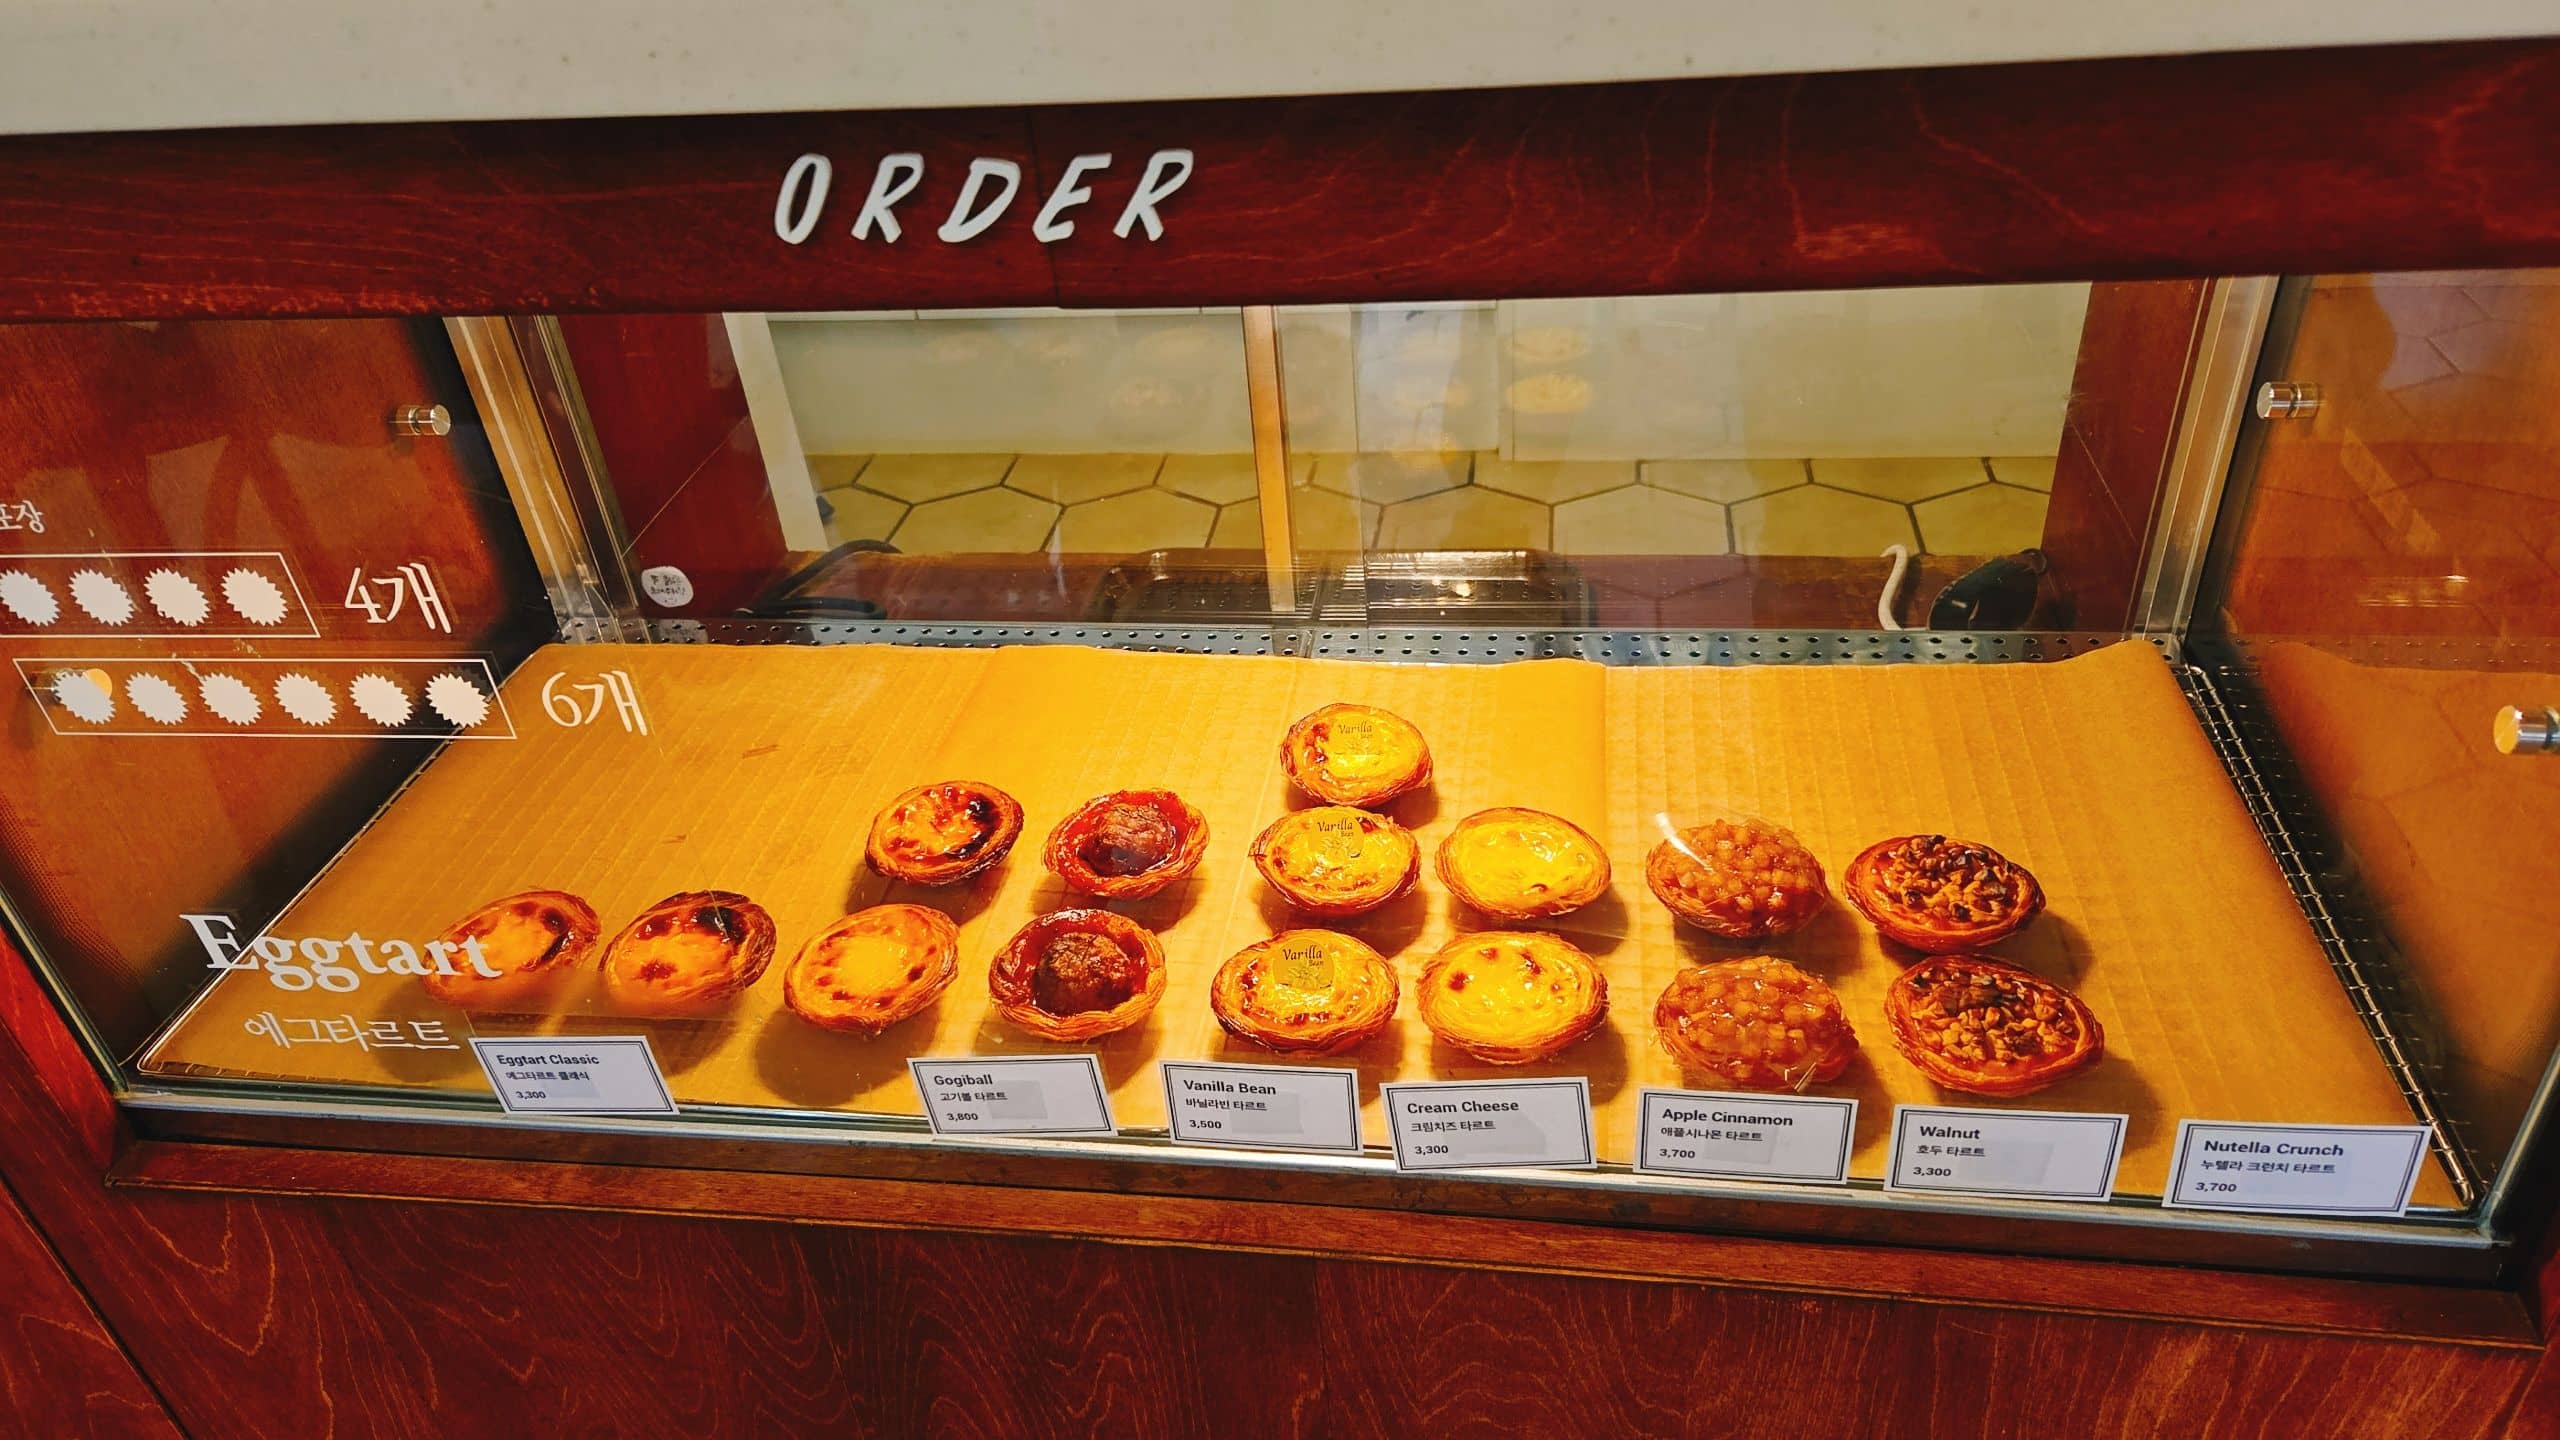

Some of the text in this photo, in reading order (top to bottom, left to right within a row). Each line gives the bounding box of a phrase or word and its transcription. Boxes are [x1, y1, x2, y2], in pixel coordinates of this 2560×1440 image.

[774, 148, 1194, 245] ORDER
[344, 562, 453, 634] 4개
[541, 670, 648, 736] 6개
[179, 914, 503, 993] Eggtart
[243, 1011, 461, 1052] 에그타르트
[496, 1053, 600, 1067] Eggtart Classic
[933, 1074, 993, 1088] Gogiball
[1183, 1079, 1277, 1095] Vanilla Bean
[515, 1091, 546, 1100] 3,300
[974, 1092, 1008, 1102] 타르트
[1185, 1098, 1268, 1112] 바닐라빈 타르트
[1407, 1100, 1520, 1114] Cream Cheese
[946, 1112, 979, 1122] 3,800
[1188, 1119, 1222, 1129] 3,500
[1662, 1108, 1794, 1126] Apple Cinnamon
[1410, 1119, 1497, 1133] 크림치즈 타르트
[1919, 1126, 1981, 1140] Walnut
[1726, 1130, 1764, 1142] 타르트
[1415, 1145, 1449, 1156] 3,300
[1659, 1148, 1696, 1159] 3,700
[1916, 1144, 1986, 1158] 호두 타르트
[2203, 1140, 2344, 1156] Nutella Crunch
[1912, 1166, 1952, 1177] 3,300
[2200, 1159, 2337, 1174] 누텔라 크런치 타르트
[2195, 1181, 2238, 1193] 3,700
